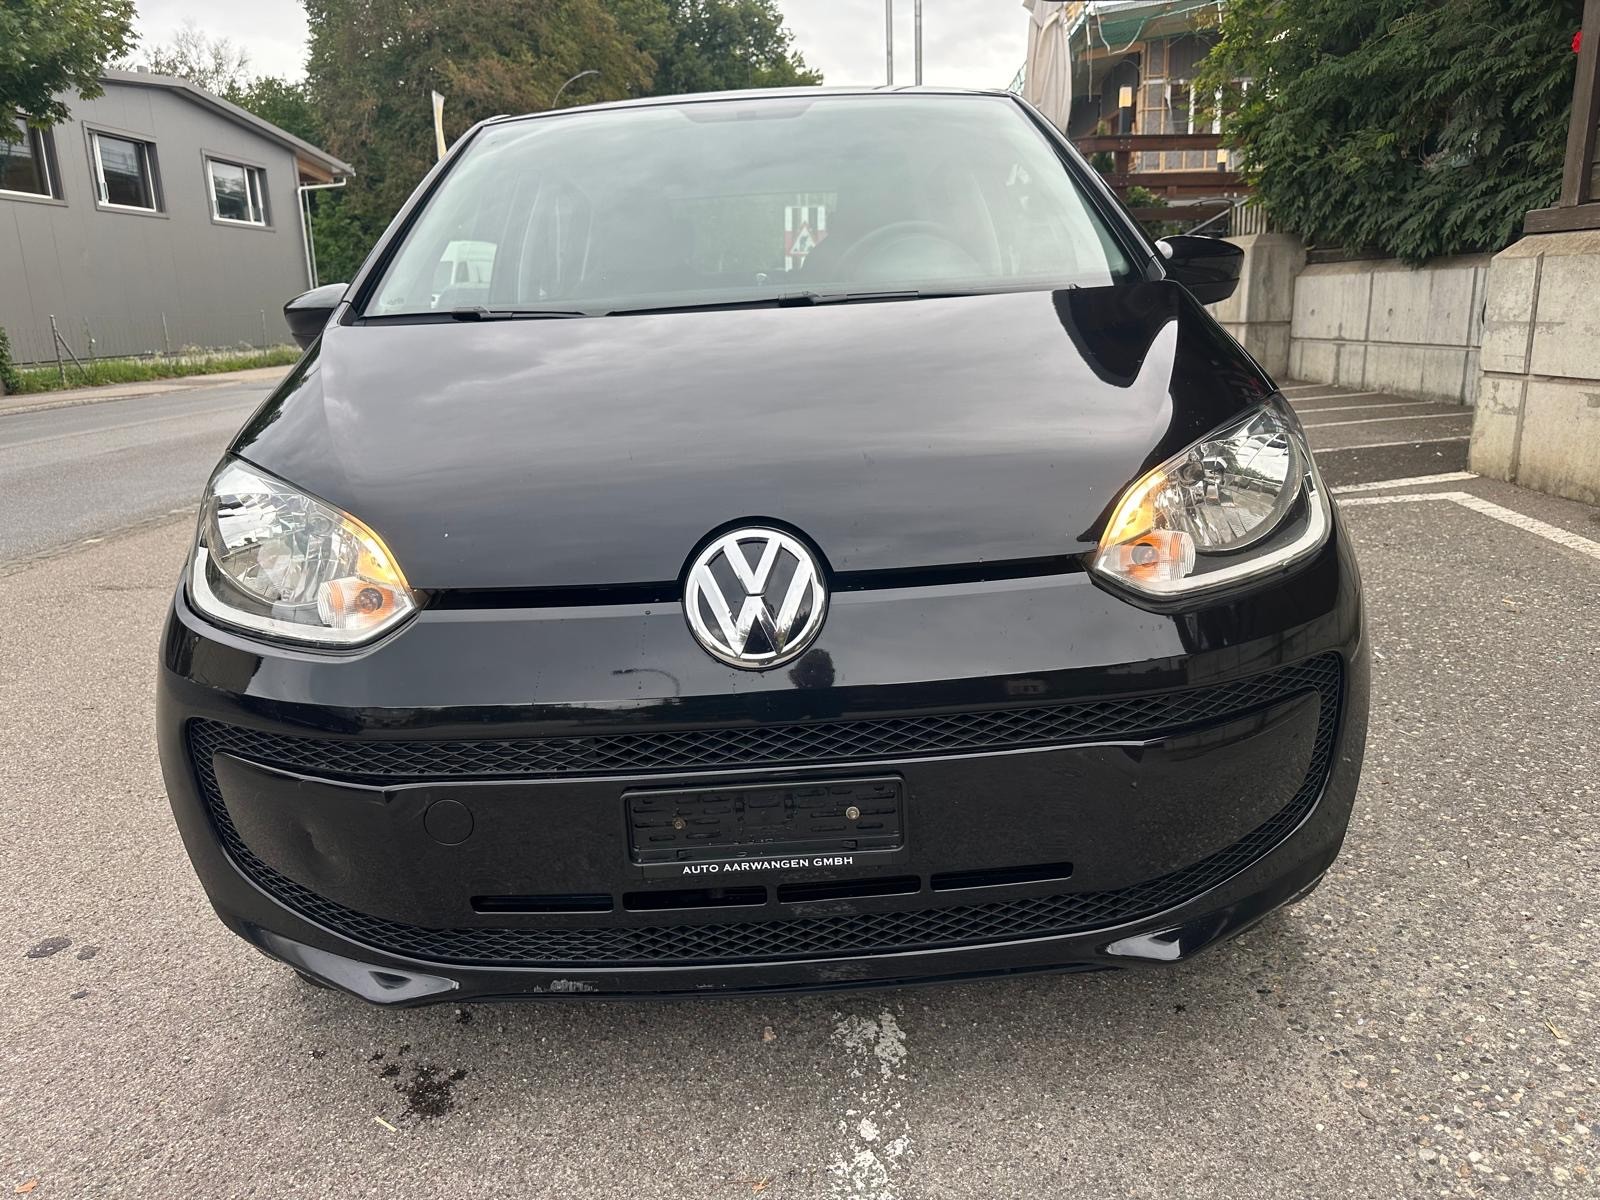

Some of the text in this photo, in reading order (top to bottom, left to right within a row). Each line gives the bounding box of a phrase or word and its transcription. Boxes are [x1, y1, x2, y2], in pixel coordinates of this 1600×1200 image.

[689, 530, 822, 664] VW
[682, 856, 853, 875] AUTO AARWANGEN GMBH
